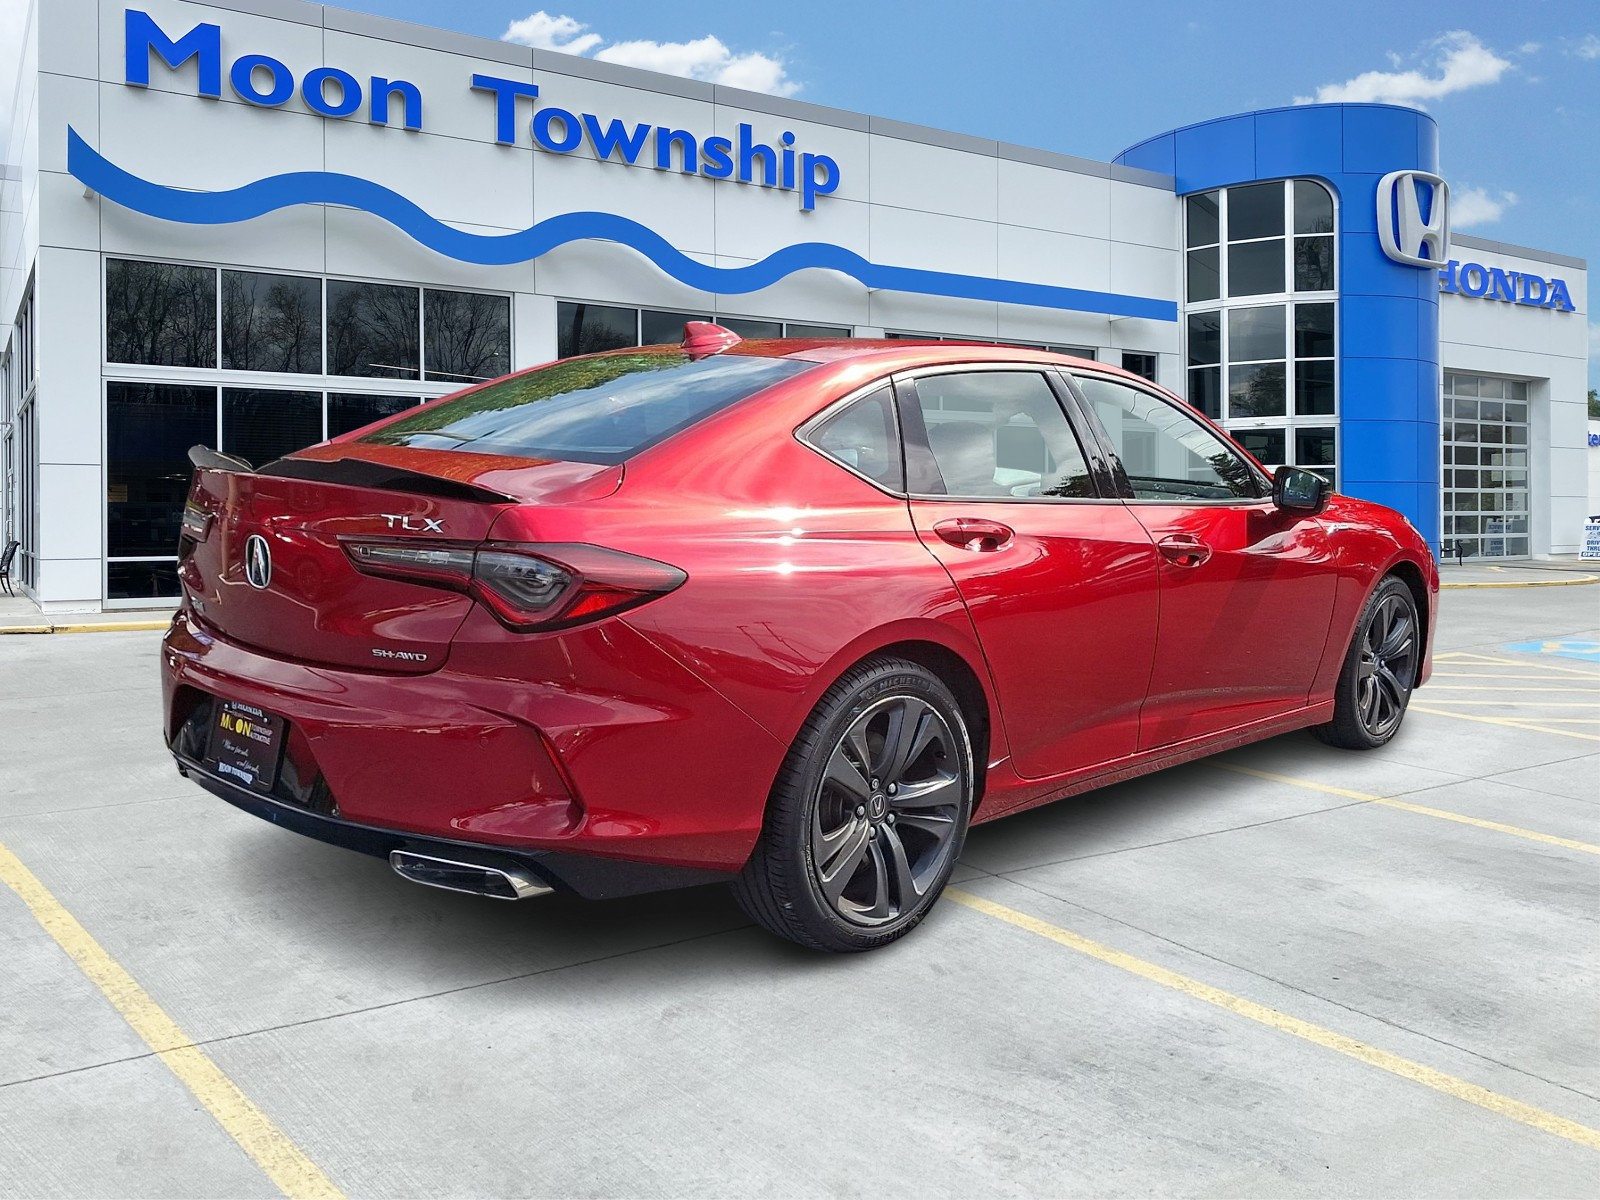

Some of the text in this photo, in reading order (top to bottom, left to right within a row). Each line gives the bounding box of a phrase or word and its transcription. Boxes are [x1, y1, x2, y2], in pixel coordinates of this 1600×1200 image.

[125, 8, 841, 213] Moon Township
[1439, 259, 1576, 312] HONDA
[380, 513, 445, 534] TLX
[372, 648, 428, 662] SH-AWD
